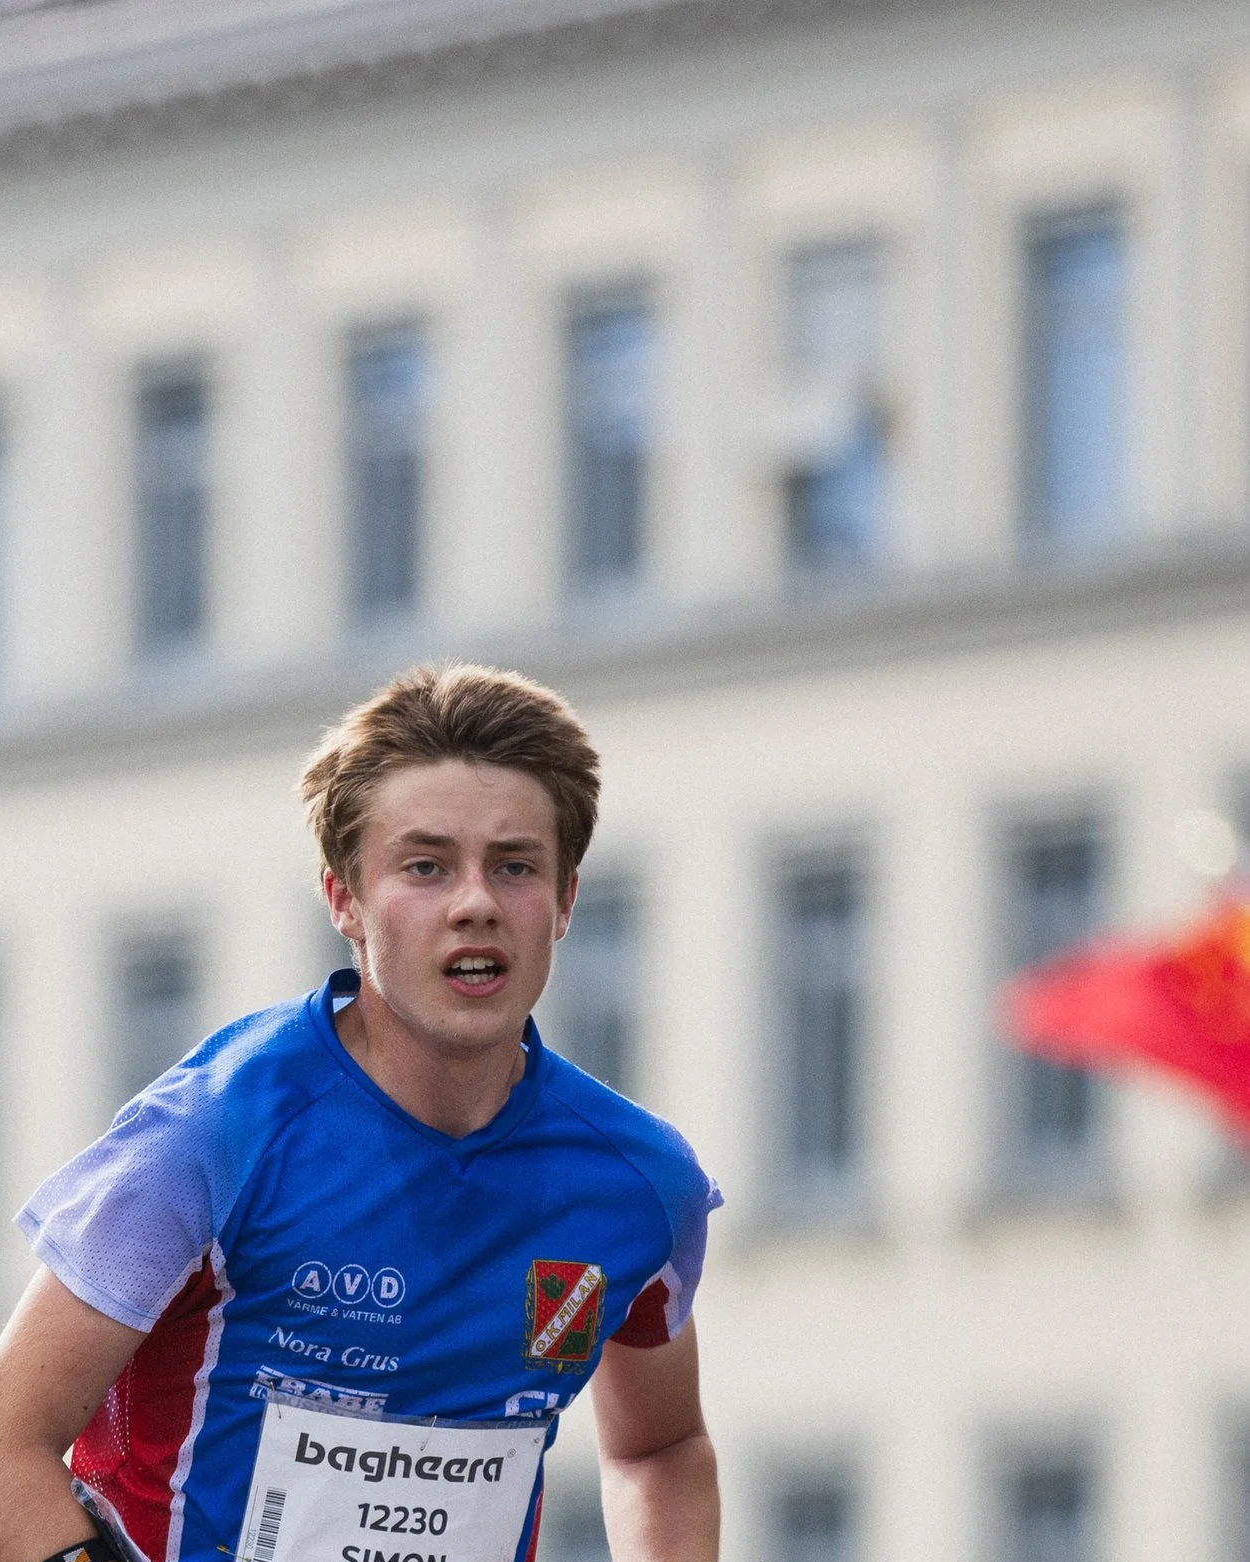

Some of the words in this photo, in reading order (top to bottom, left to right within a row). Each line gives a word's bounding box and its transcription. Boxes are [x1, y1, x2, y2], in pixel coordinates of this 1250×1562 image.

[297, 1267, 401, 1302] AVD
[287, 1298, 328, 1316] VÄRME
[331, 1308, 339, 1317] &
[342, 1309, 385, 1323] VATTEN
[387, 1314, 402, 1325] AB
[268, 1326, 332, 1362] Nora
[341, 1346, 400, 1372] Grus
[294, 1432, 504, 1483] bagheera
[358, 1502, 448, 1536] 12230
